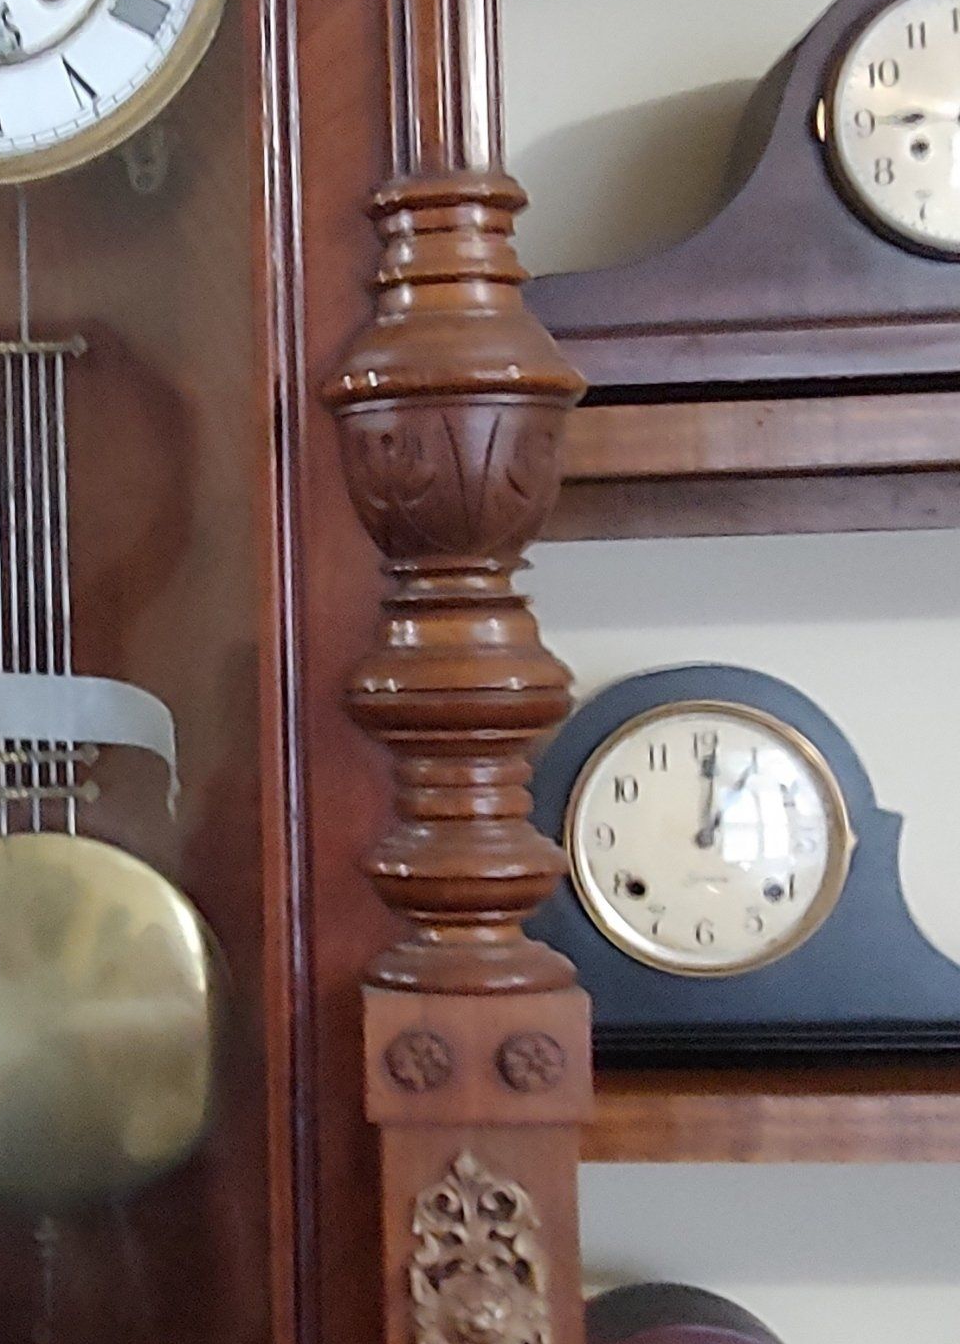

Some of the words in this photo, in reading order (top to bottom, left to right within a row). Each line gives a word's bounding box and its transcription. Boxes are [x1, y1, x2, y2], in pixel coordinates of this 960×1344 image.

[906, 21, 926, 49] 11
[868, 59, 899, 88] 10
[854, 108, 876, 137] 9
[874, 157, 895, 185] 8
[648, 743, 668, 771] 11
[614, 775, 639, 804] 10
[596, 822, 616, 851] 9
[695, 917, 715, 946] 6
